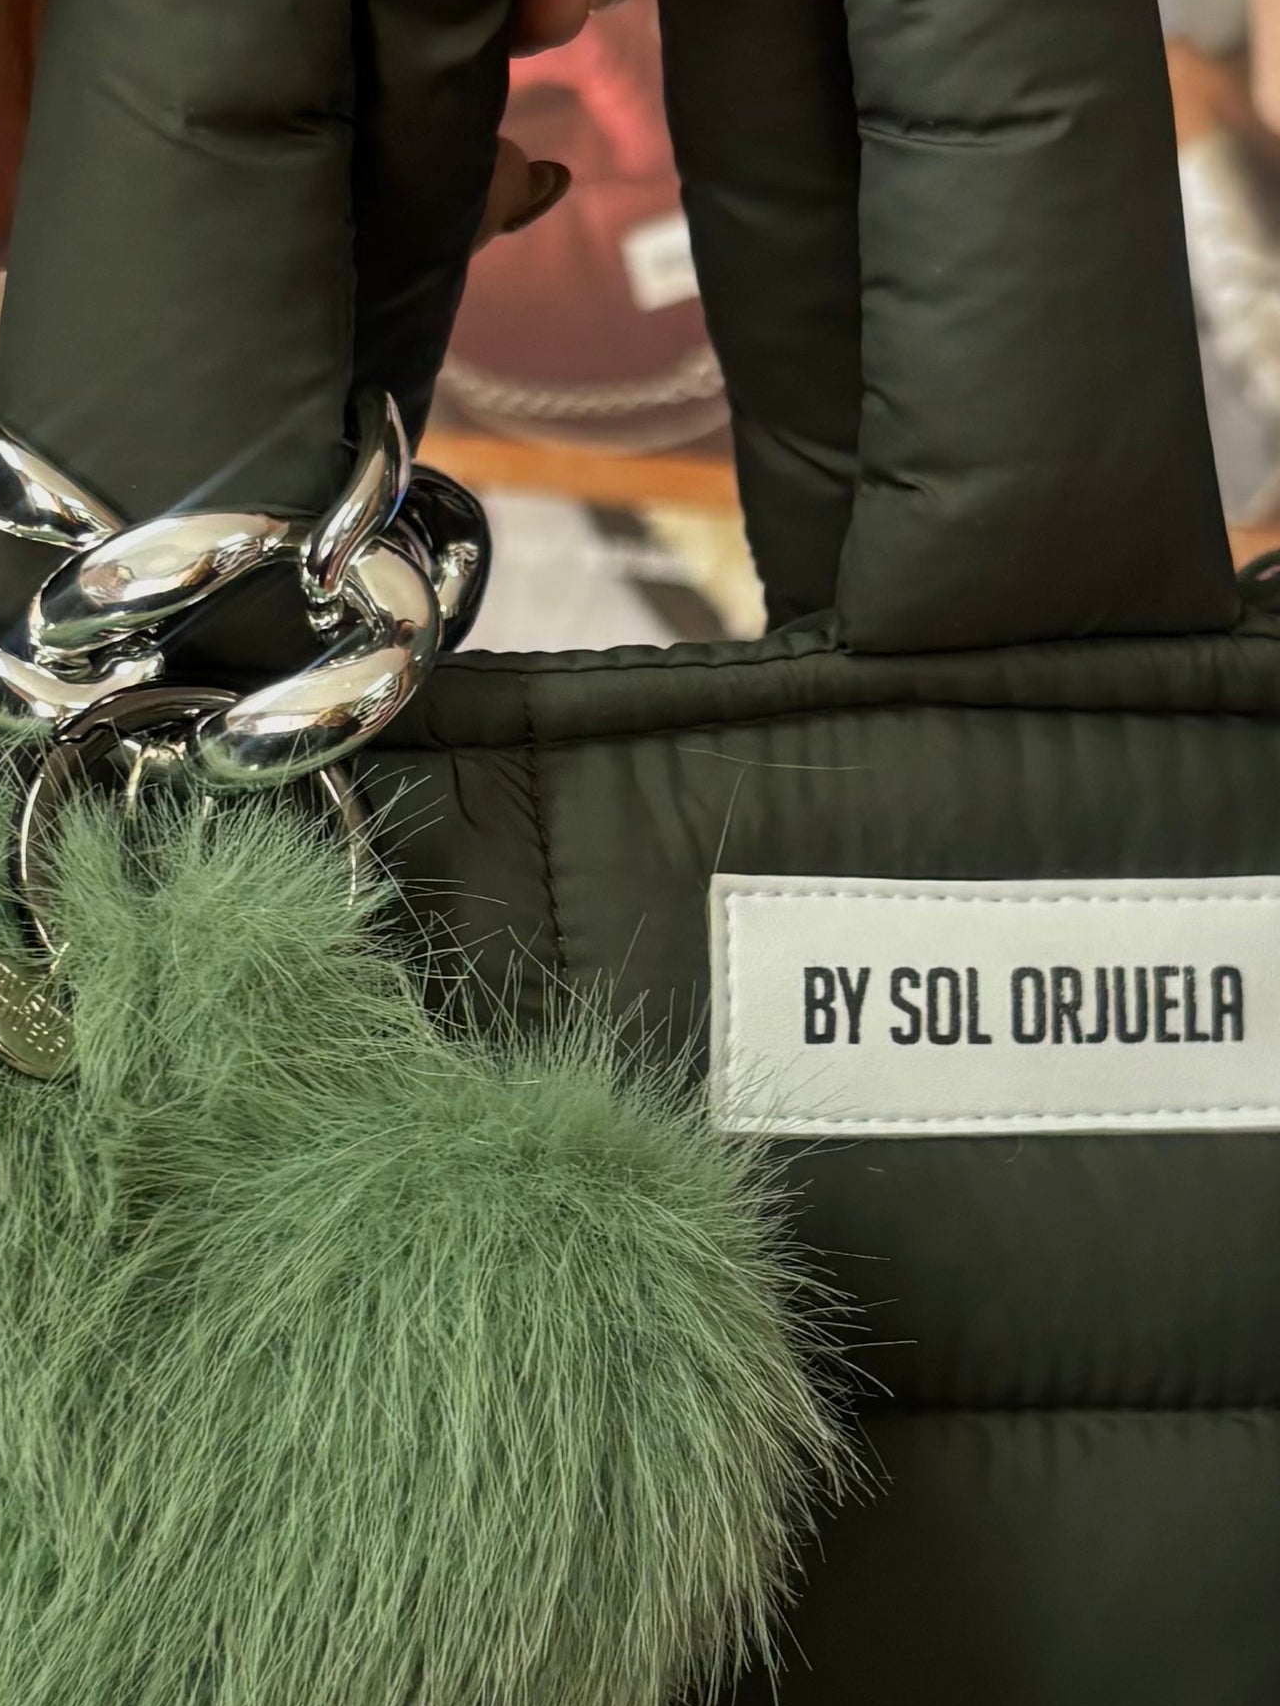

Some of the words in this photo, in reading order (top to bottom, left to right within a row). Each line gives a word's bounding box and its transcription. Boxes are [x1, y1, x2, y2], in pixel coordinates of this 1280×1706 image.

[803, 966, 872, 1046] BY
[888, 966, 992, 1046] SOL
[1010, 964, 1246, 1045] ORJUELA
